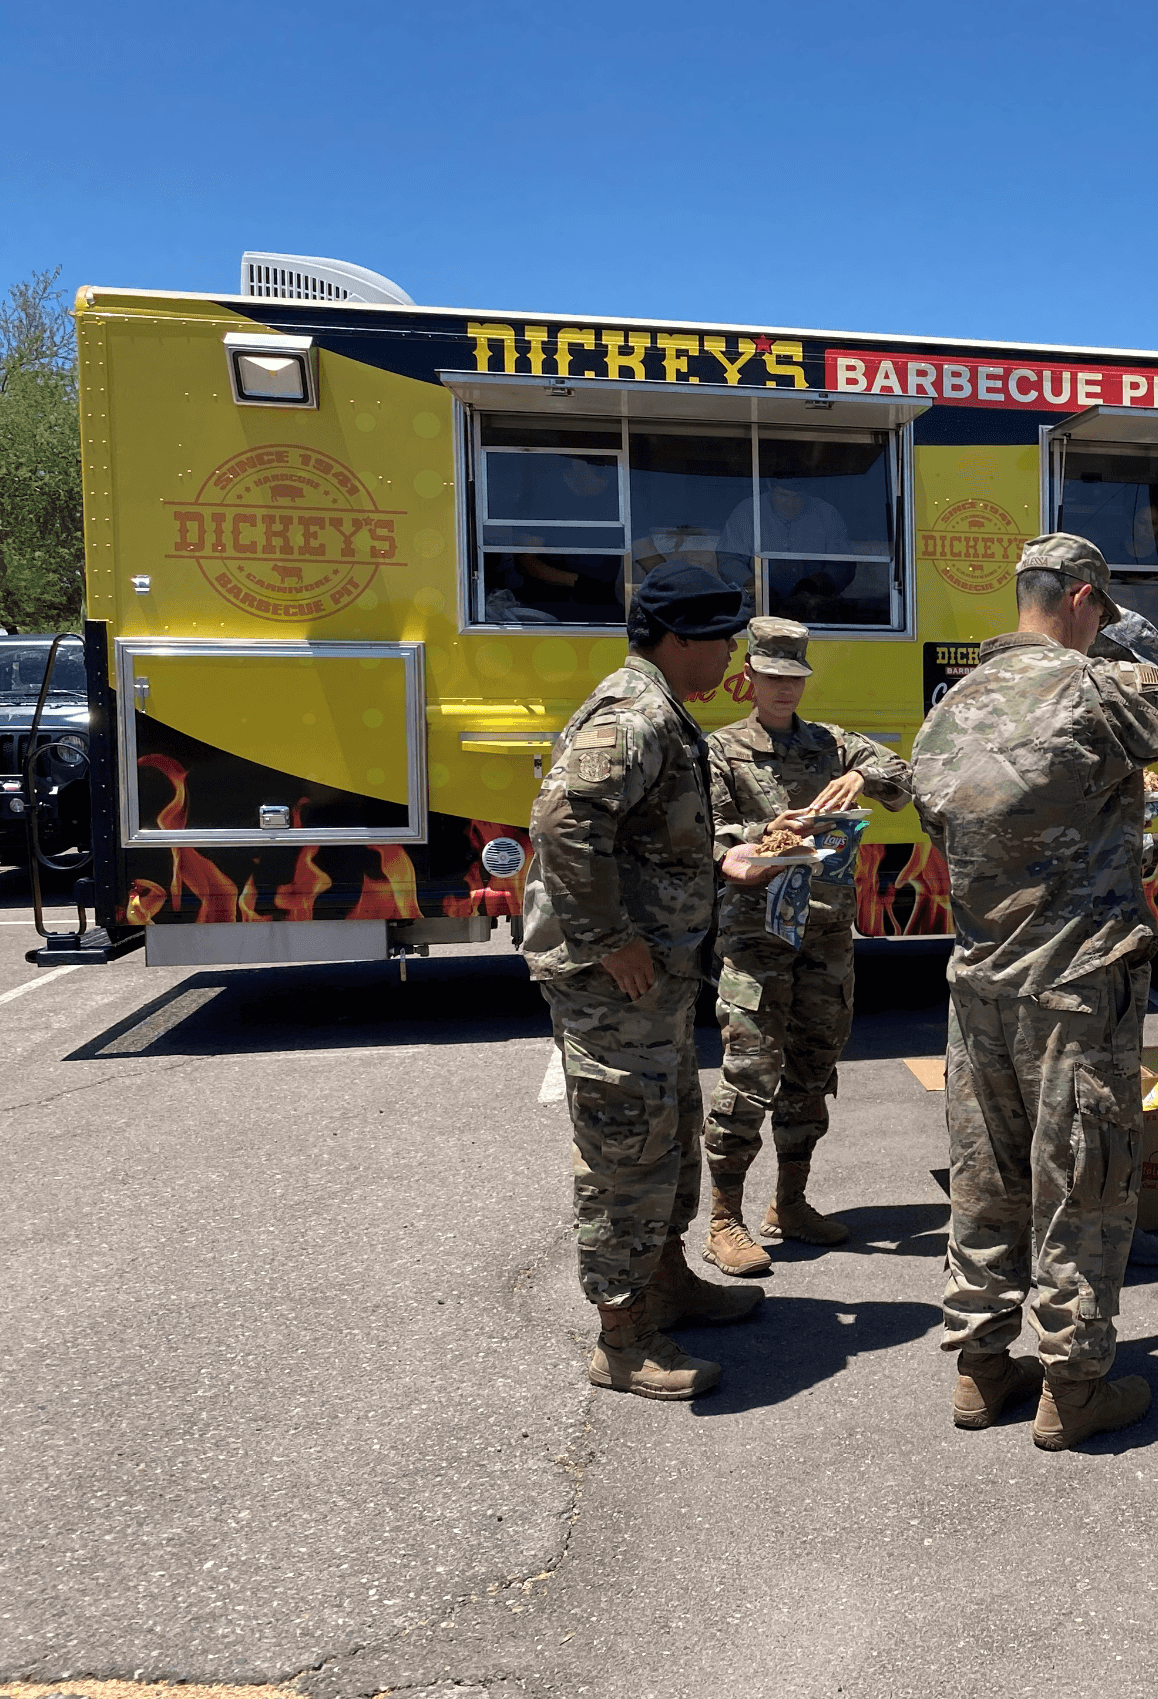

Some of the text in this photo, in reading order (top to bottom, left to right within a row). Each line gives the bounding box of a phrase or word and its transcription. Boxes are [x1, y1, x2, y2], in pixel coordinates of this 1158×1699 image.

[467, 321, 809, 389] DICKEY'S
[836, 357, 1104, 407] BARBECUE
[213, 450, 361, 497] SINCE 1941
[253, 473, 321, 489] HARDCORE
[173, 510, 398, 560] DICKEY'S
[941, 501, 1012, 527] SINCE 1941
[214, 572, 361, 617] BARBECUE PIT
[245, 572, 332, 594] CARNIVORE
[941, 569, 1012, 591] BARBECUE PIT
